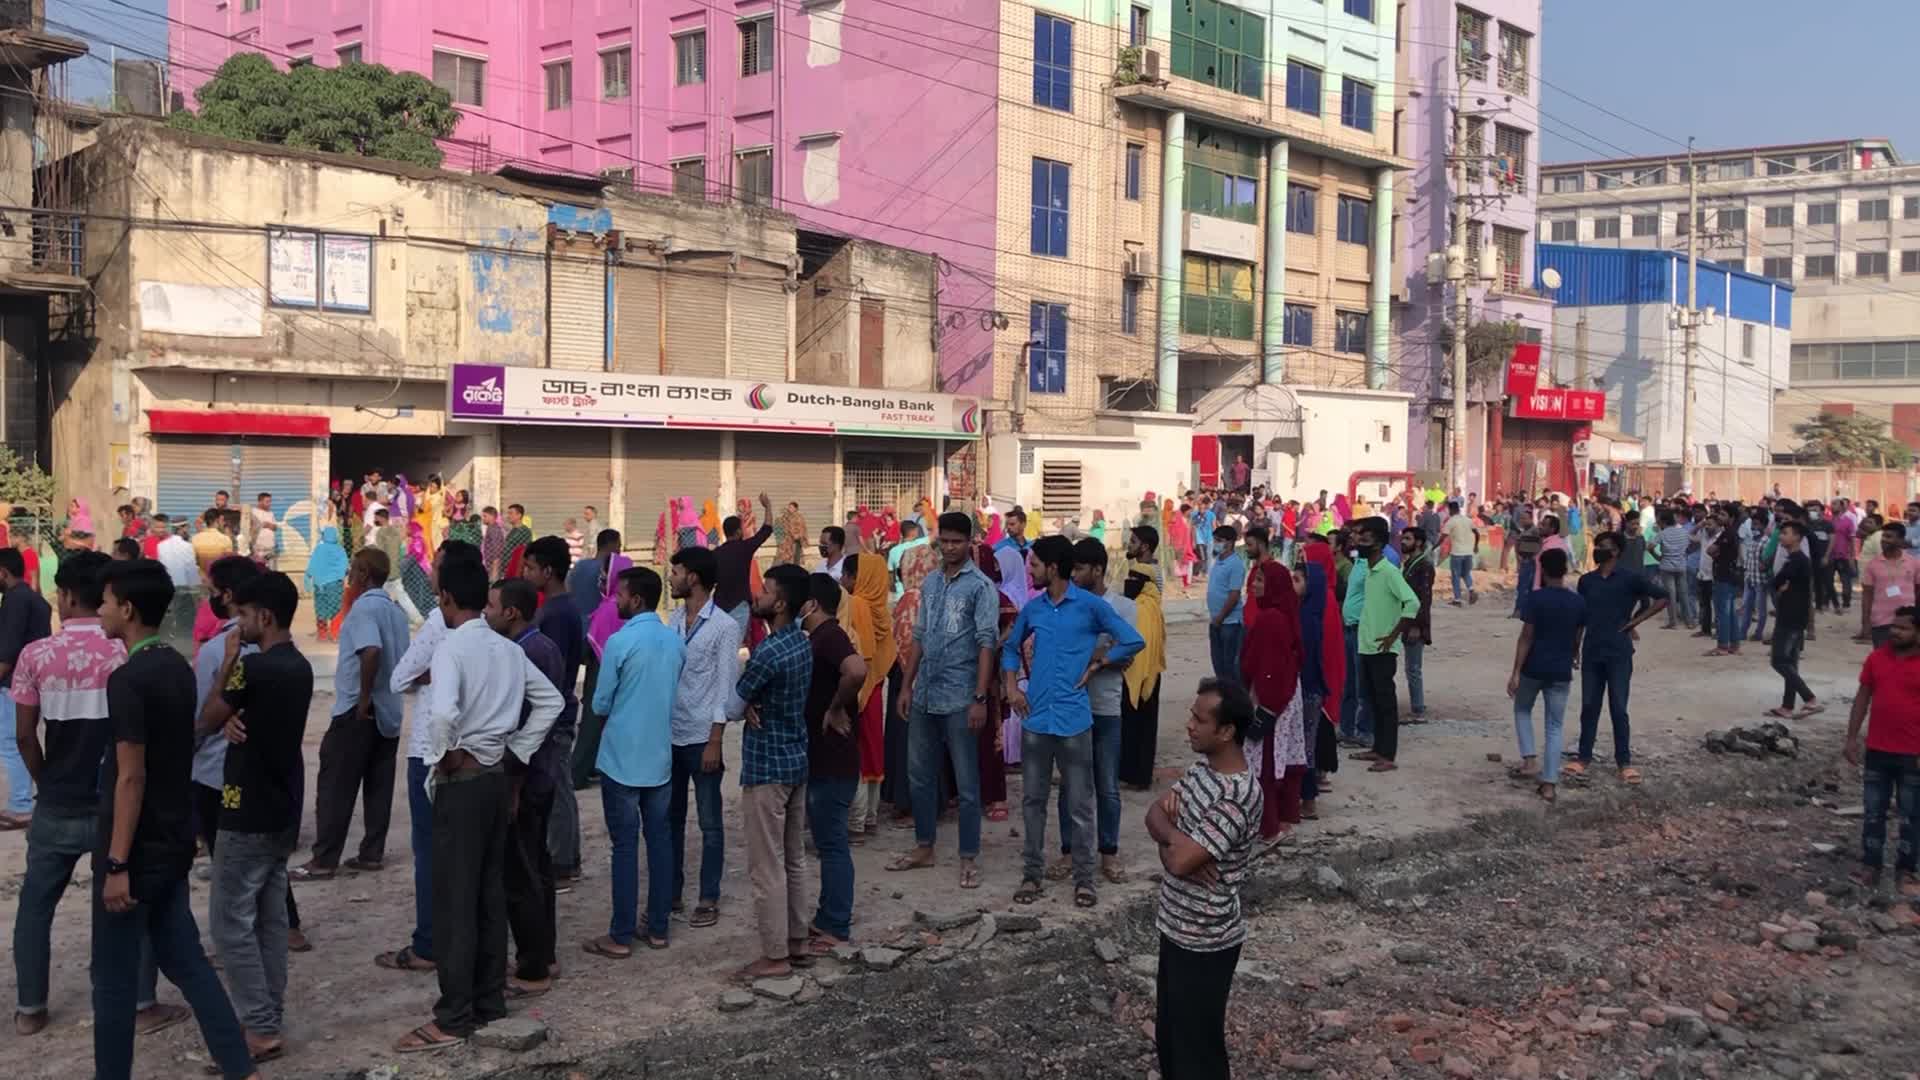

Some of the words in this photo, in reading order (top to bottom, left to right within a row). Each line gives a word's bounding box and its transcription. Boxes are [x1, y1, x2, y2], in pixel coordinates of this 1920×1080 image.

[1510, 362, 1537, 372] VISIN
[667, 385, 733, 401] ব্যাংক
[787, 392, 894, 410] Dutch-Bangla
[899, 399, 935, 411] Bank
[1530, 395, 1563, 412] VISIN
[881, 413, 903, 421] FAST
[906, 414, 935, 422] TRACK
